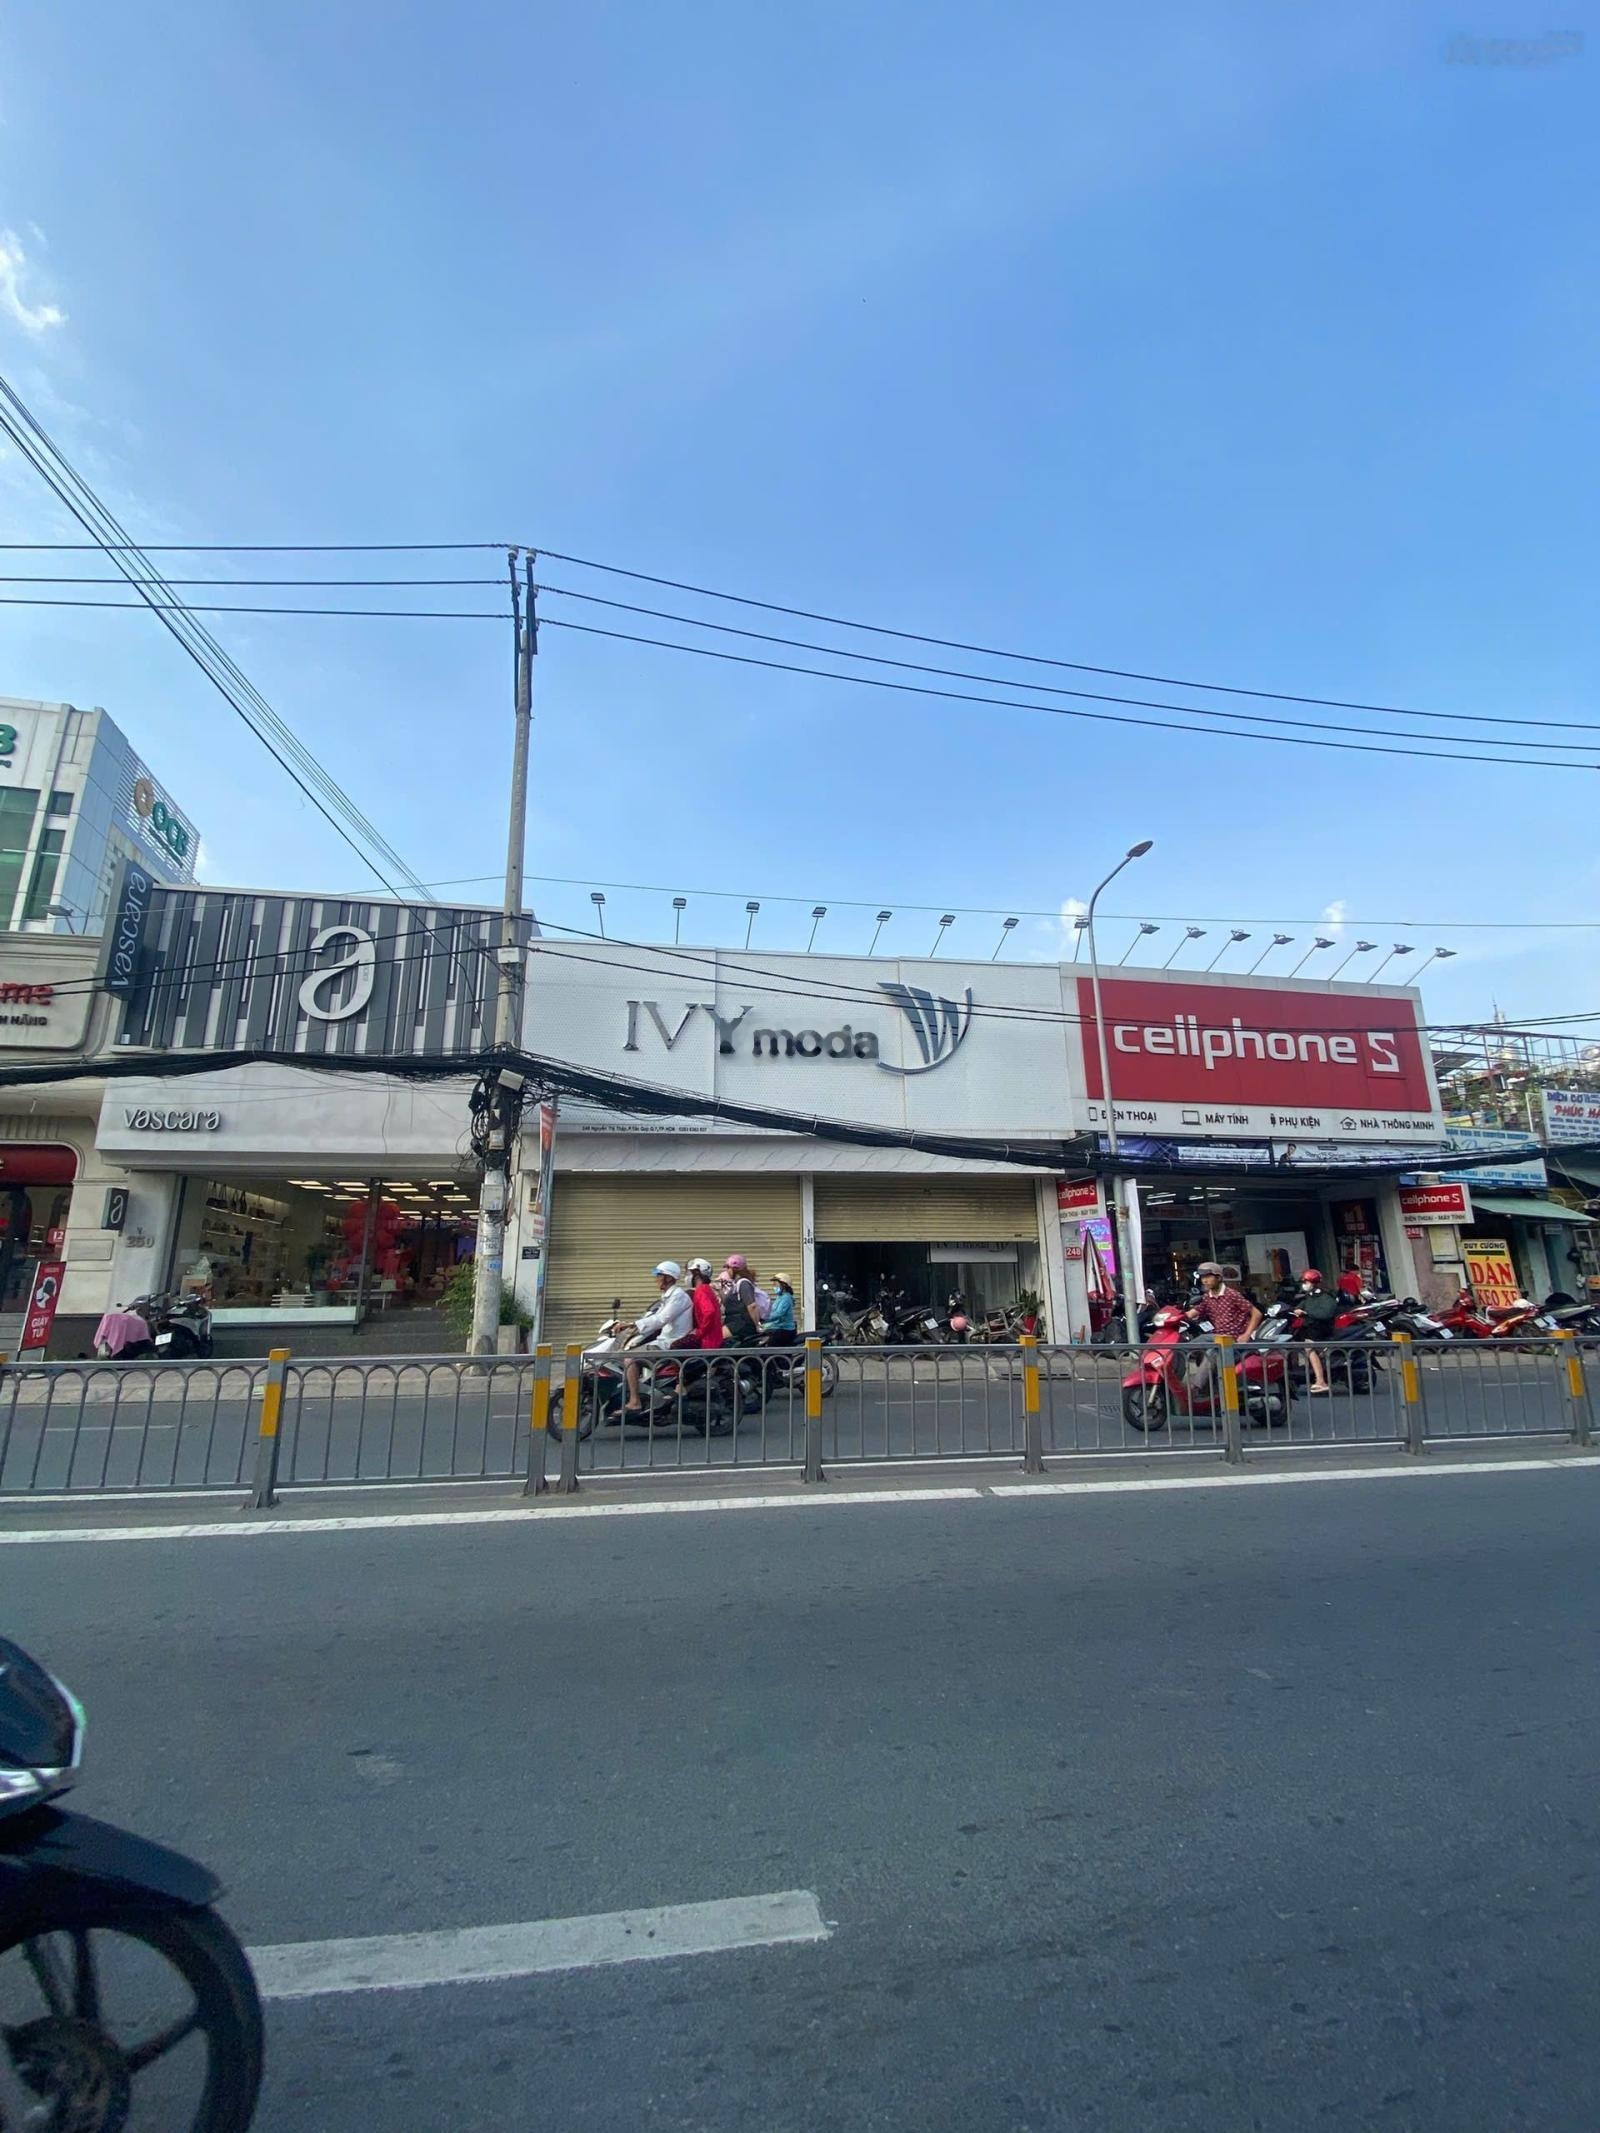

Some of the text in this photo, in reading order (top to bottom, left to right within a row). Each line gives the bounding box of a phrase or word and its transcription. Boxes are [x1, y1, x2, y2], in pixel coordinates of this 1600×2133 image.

[111, 872, 147, 985] vascara
[623, 1000, 880, 1060] IVY moda
[124, 1108, 221, 1131] vascara
[1126, 1111, 1157, 1123] THOẠI
[1205, 1113, 1225, 1124] MÁY
[1226, 1114, 1248, 1124] TÍNH
[1279, 1117, 1298, 1128] PHỤ
[1300, 1116, 1320, 1128] KIỆN
[1360, 1117, 1379, 1129] NHÀ
[1381, 1119, 1411, 1129] THÔNG
[1412, 1120, 1435, 1130] MINH
[1469, 1256, 1513, 1285] DÁN
